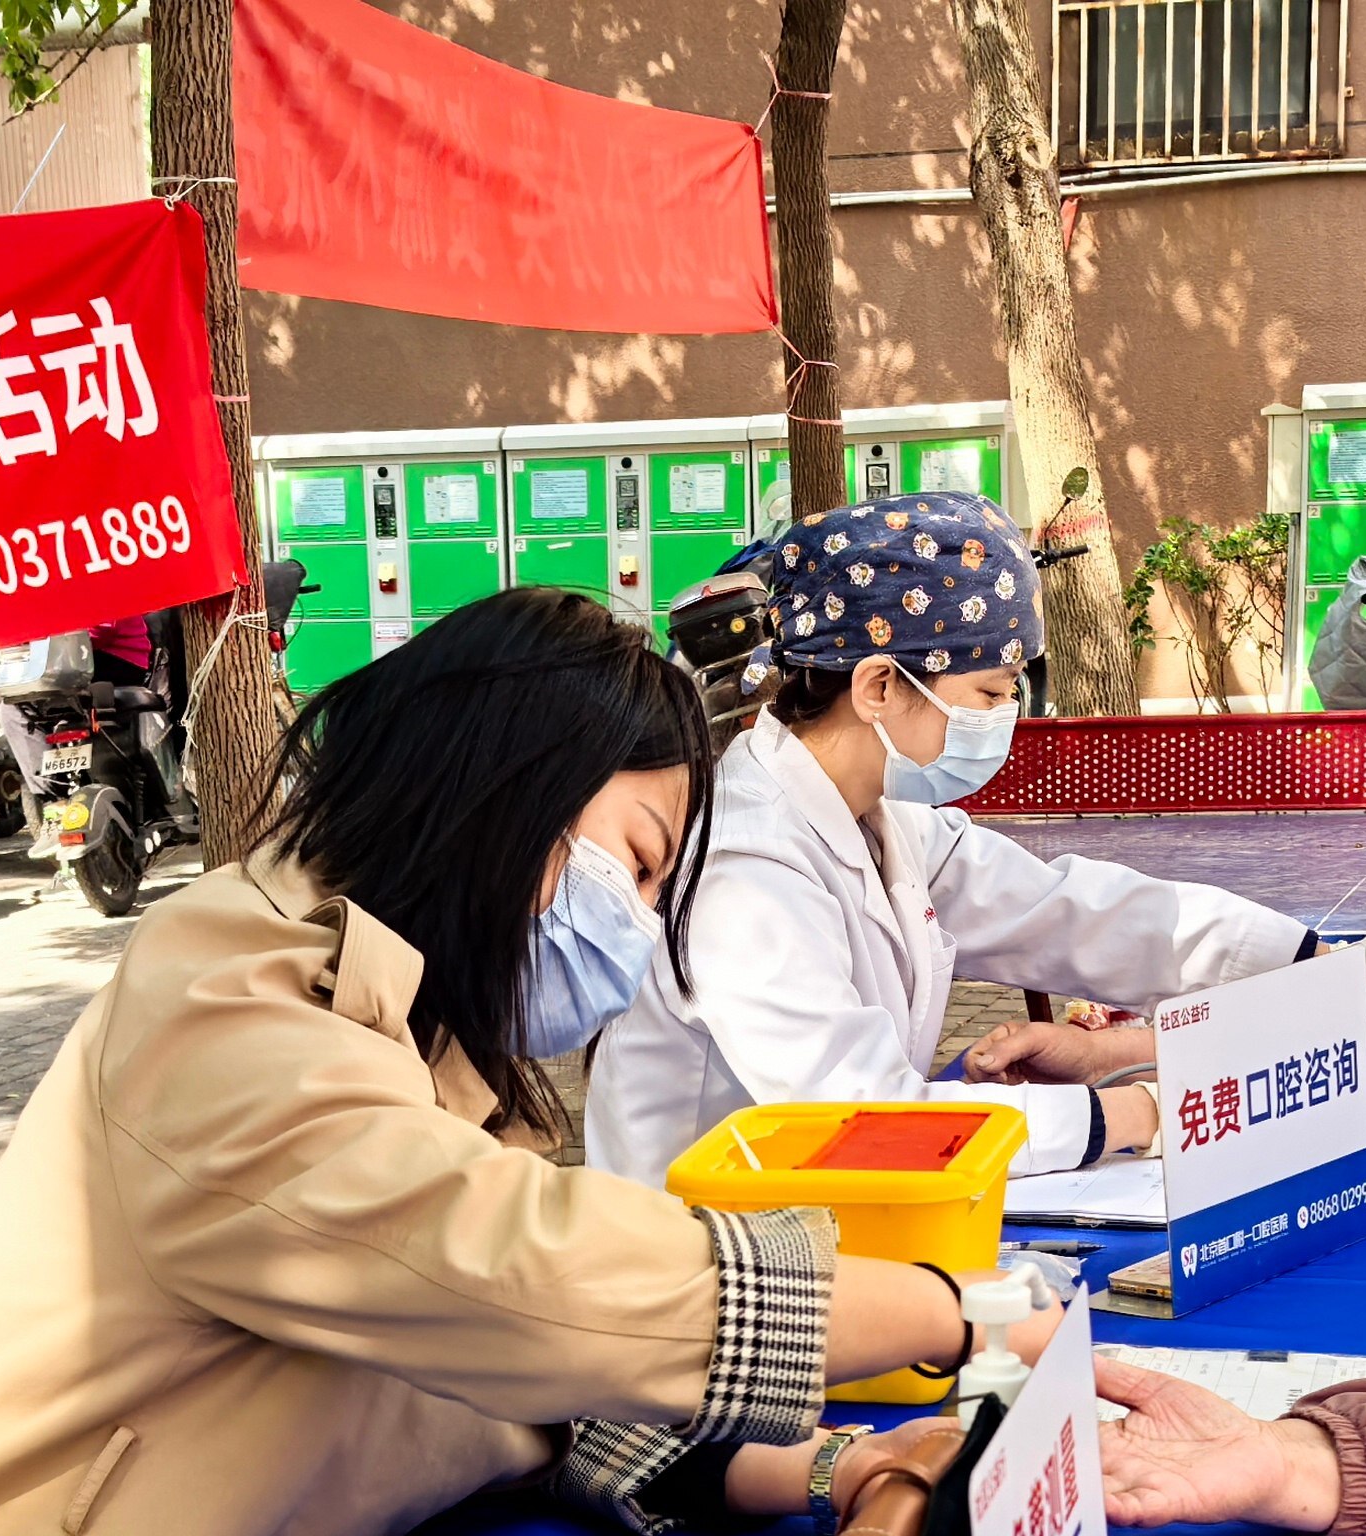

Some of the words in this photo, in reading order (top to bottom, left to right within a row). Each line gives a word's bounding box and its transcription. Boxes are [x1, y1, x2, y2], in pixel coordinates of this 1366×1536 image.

[1159, 1001, 1210, 1032] 社区公益行
[1177, 1038, 1360, 1152] 免费口腔咨询
[1309, 1193, 1340, 1225] 8868
